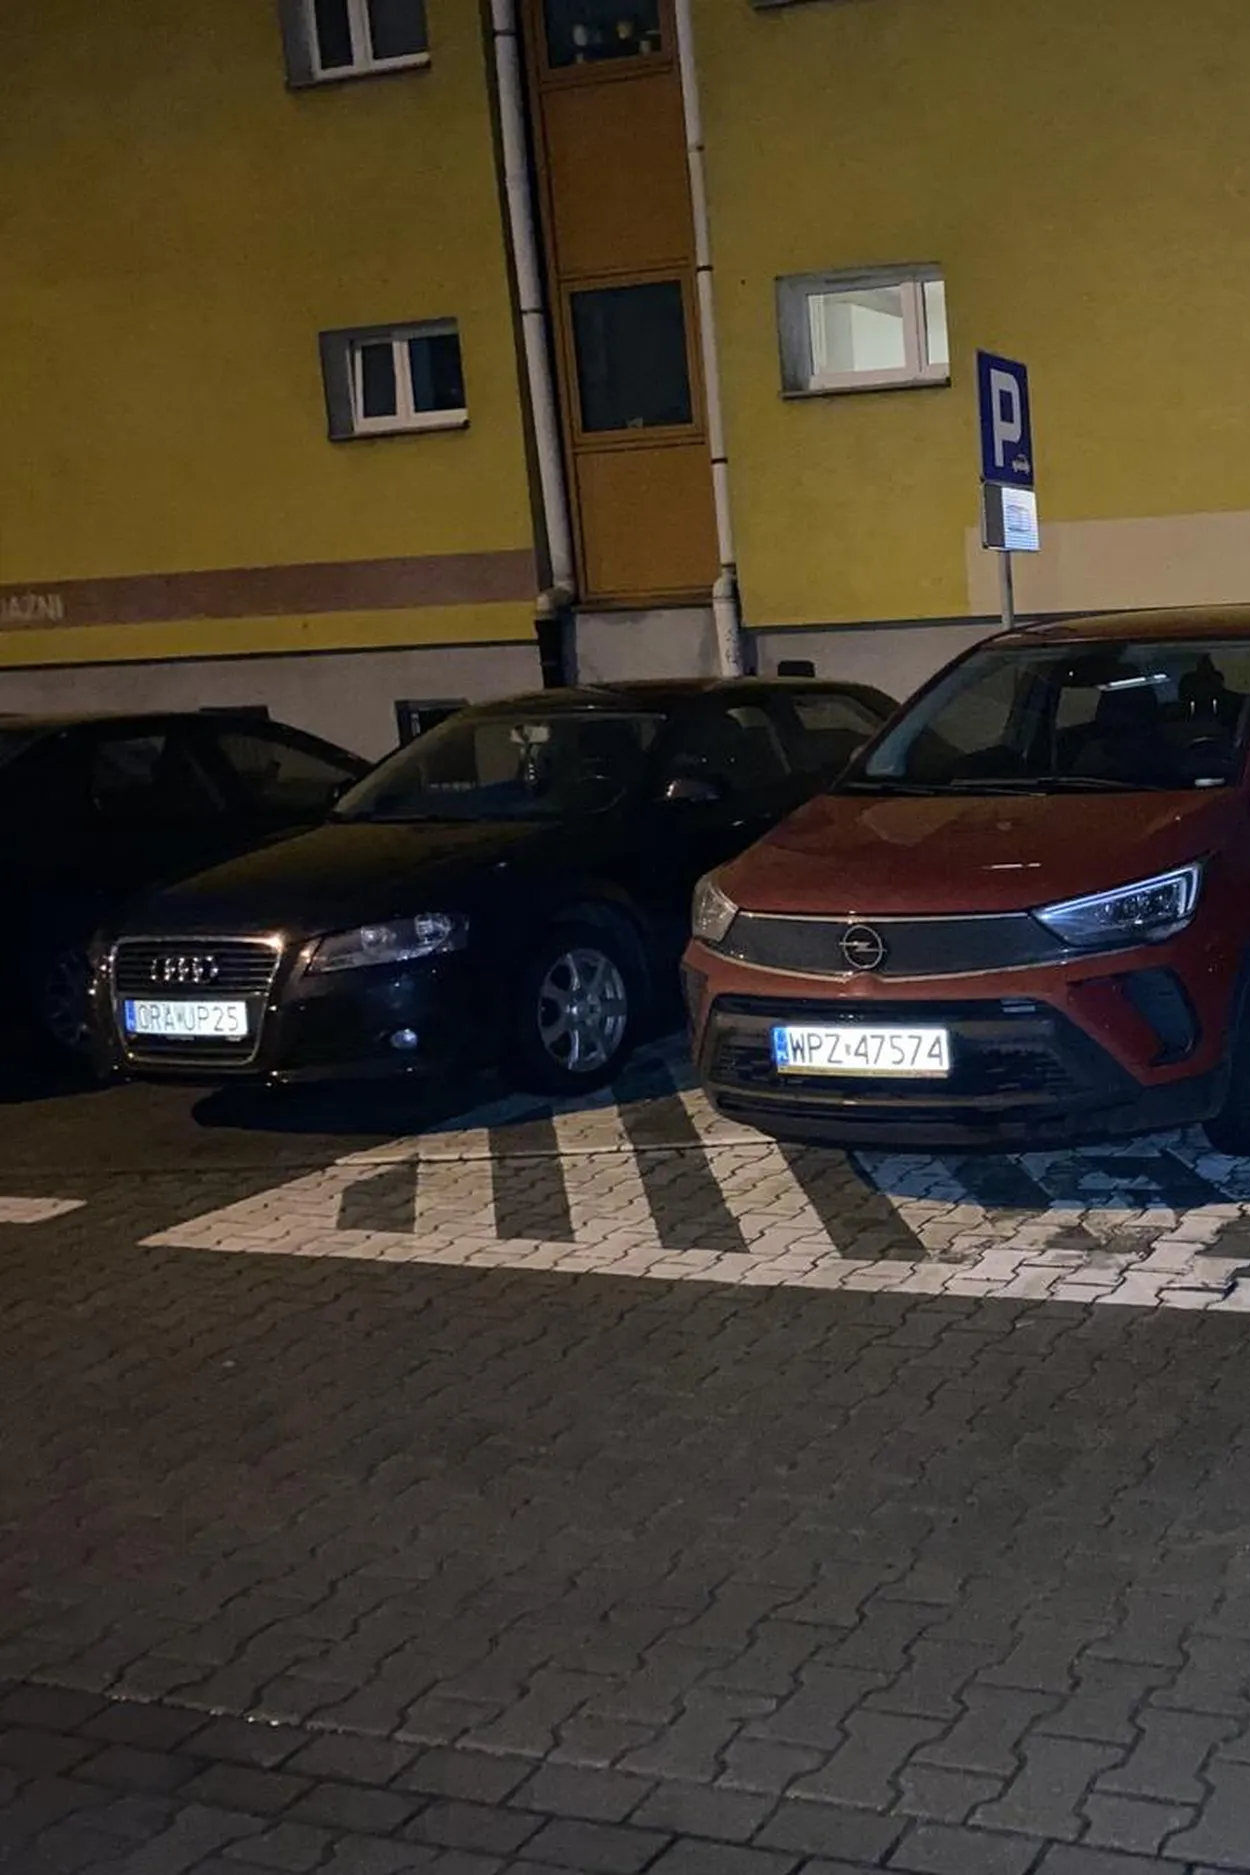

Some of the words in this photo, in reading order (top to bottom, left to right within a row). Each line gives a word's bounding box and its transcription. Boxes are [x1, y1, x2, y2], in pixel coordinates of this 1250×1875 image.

[989, 368, 1021, 467] P
[789, 1032, 843, 1064] WPZ
[854, 1034, 944, 1067] 47574
